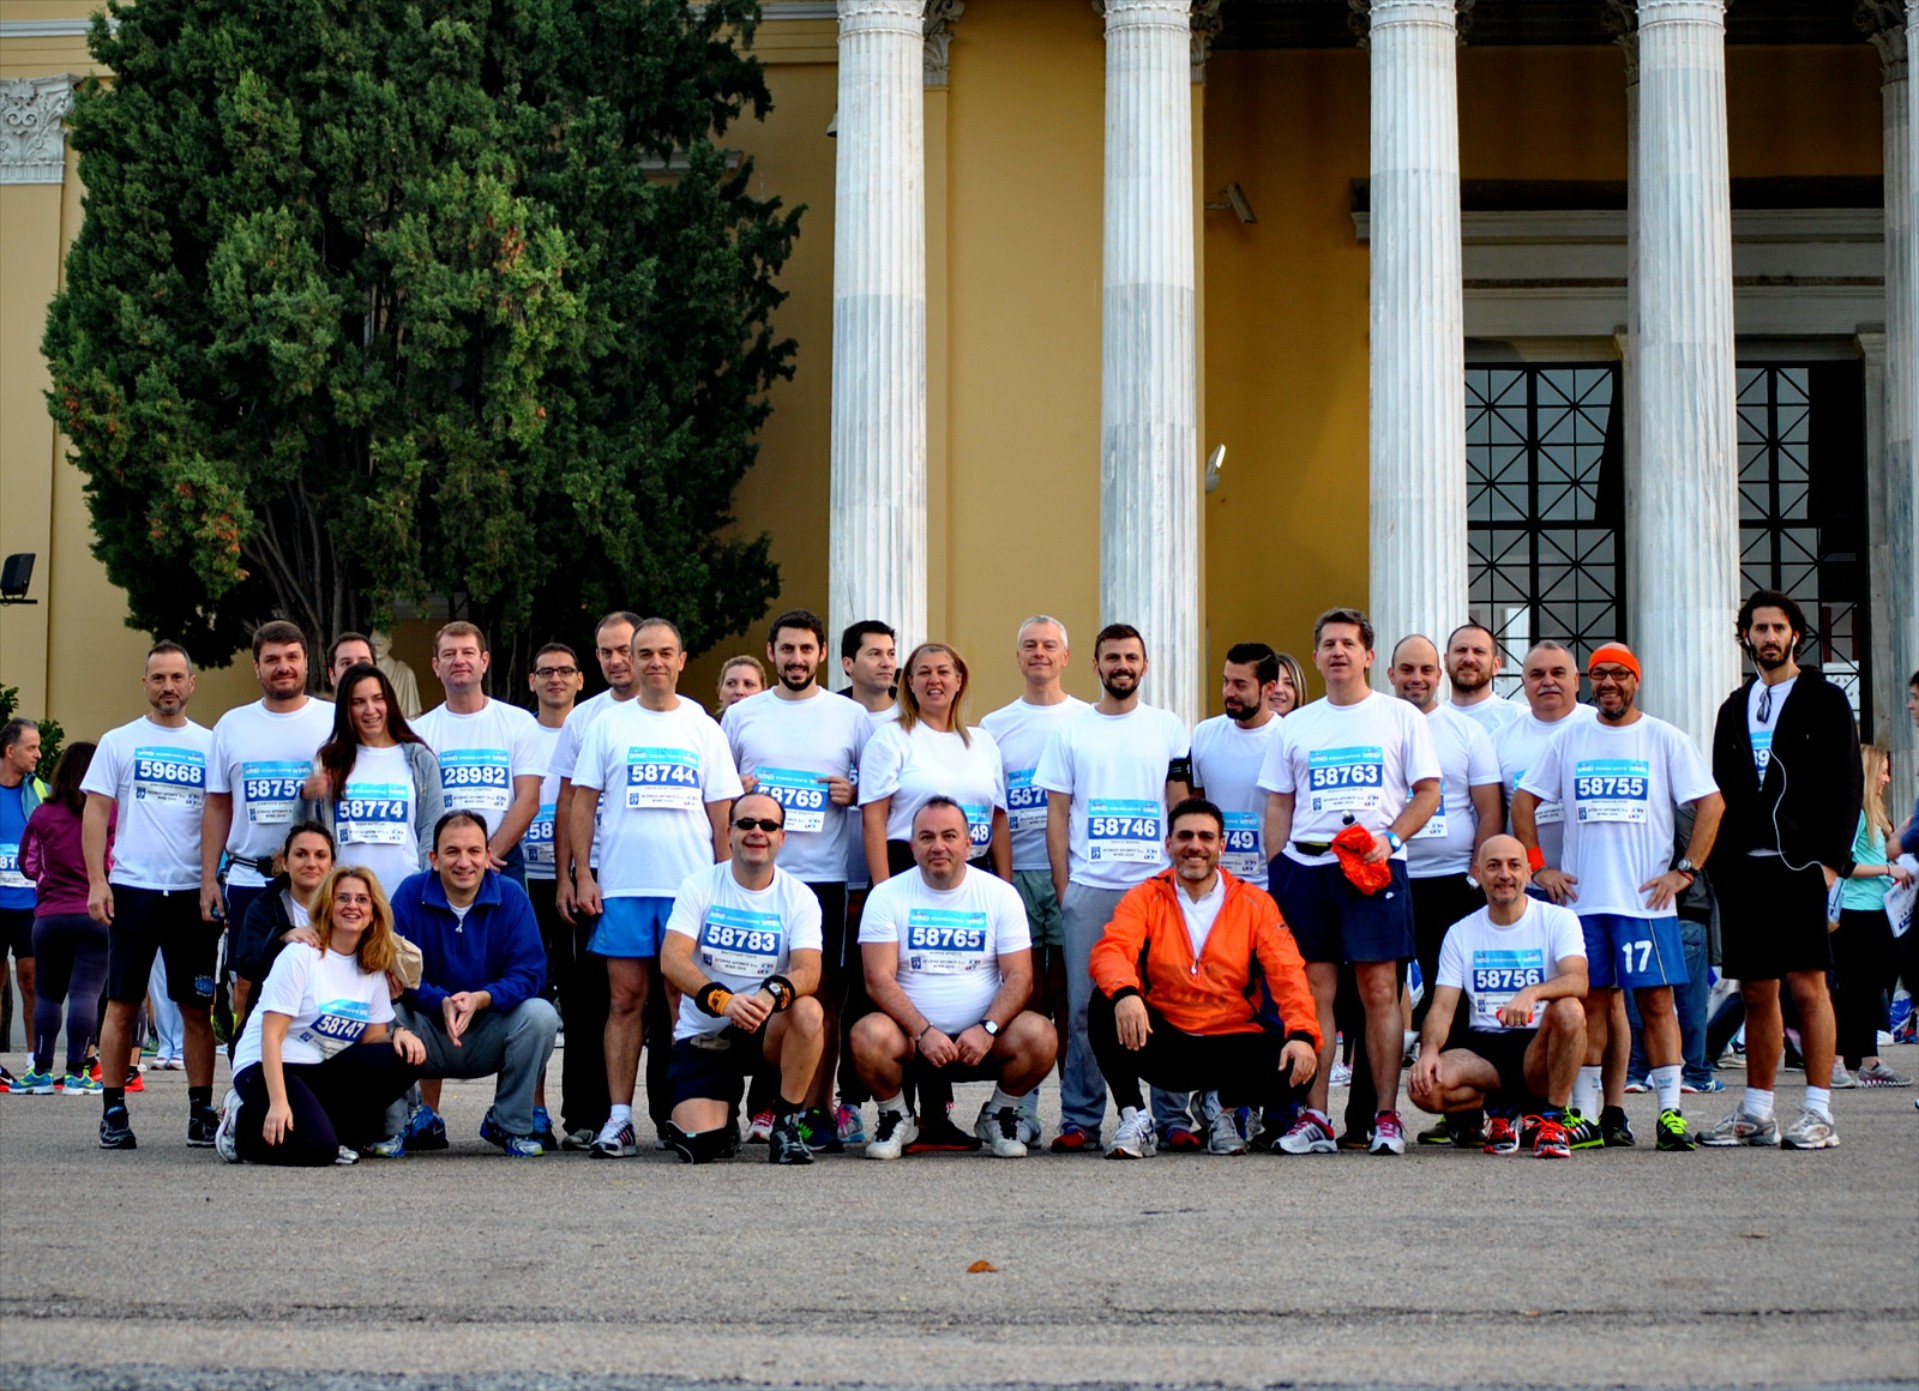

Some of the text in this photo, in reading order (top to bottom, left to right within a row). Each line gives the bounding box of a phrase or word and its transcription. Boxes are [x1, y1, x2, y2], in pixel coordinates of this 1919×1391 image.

[139, 760, 202, 783] 59668
[444, 765, 506, 785] 28982
[631, 764, 695, 784] 58744
[1313, 765, 1378, 786] 58763
[1010, 787, 1048, 806] 587
[1579, 777, 1643, 796] 58755
[339, 800, 404, 818] 58774
[529, 822, 553, 839] 58
[1092, 818, 1156, 837] 58746
[707, 925, 776, 951] 58783
[912, 927, 980, 948] 58765
[1622, 940, 1652, 974] 17
[1477, 969, 1540, 988] 58756
[317, 1016, 366, 1038] 58747
